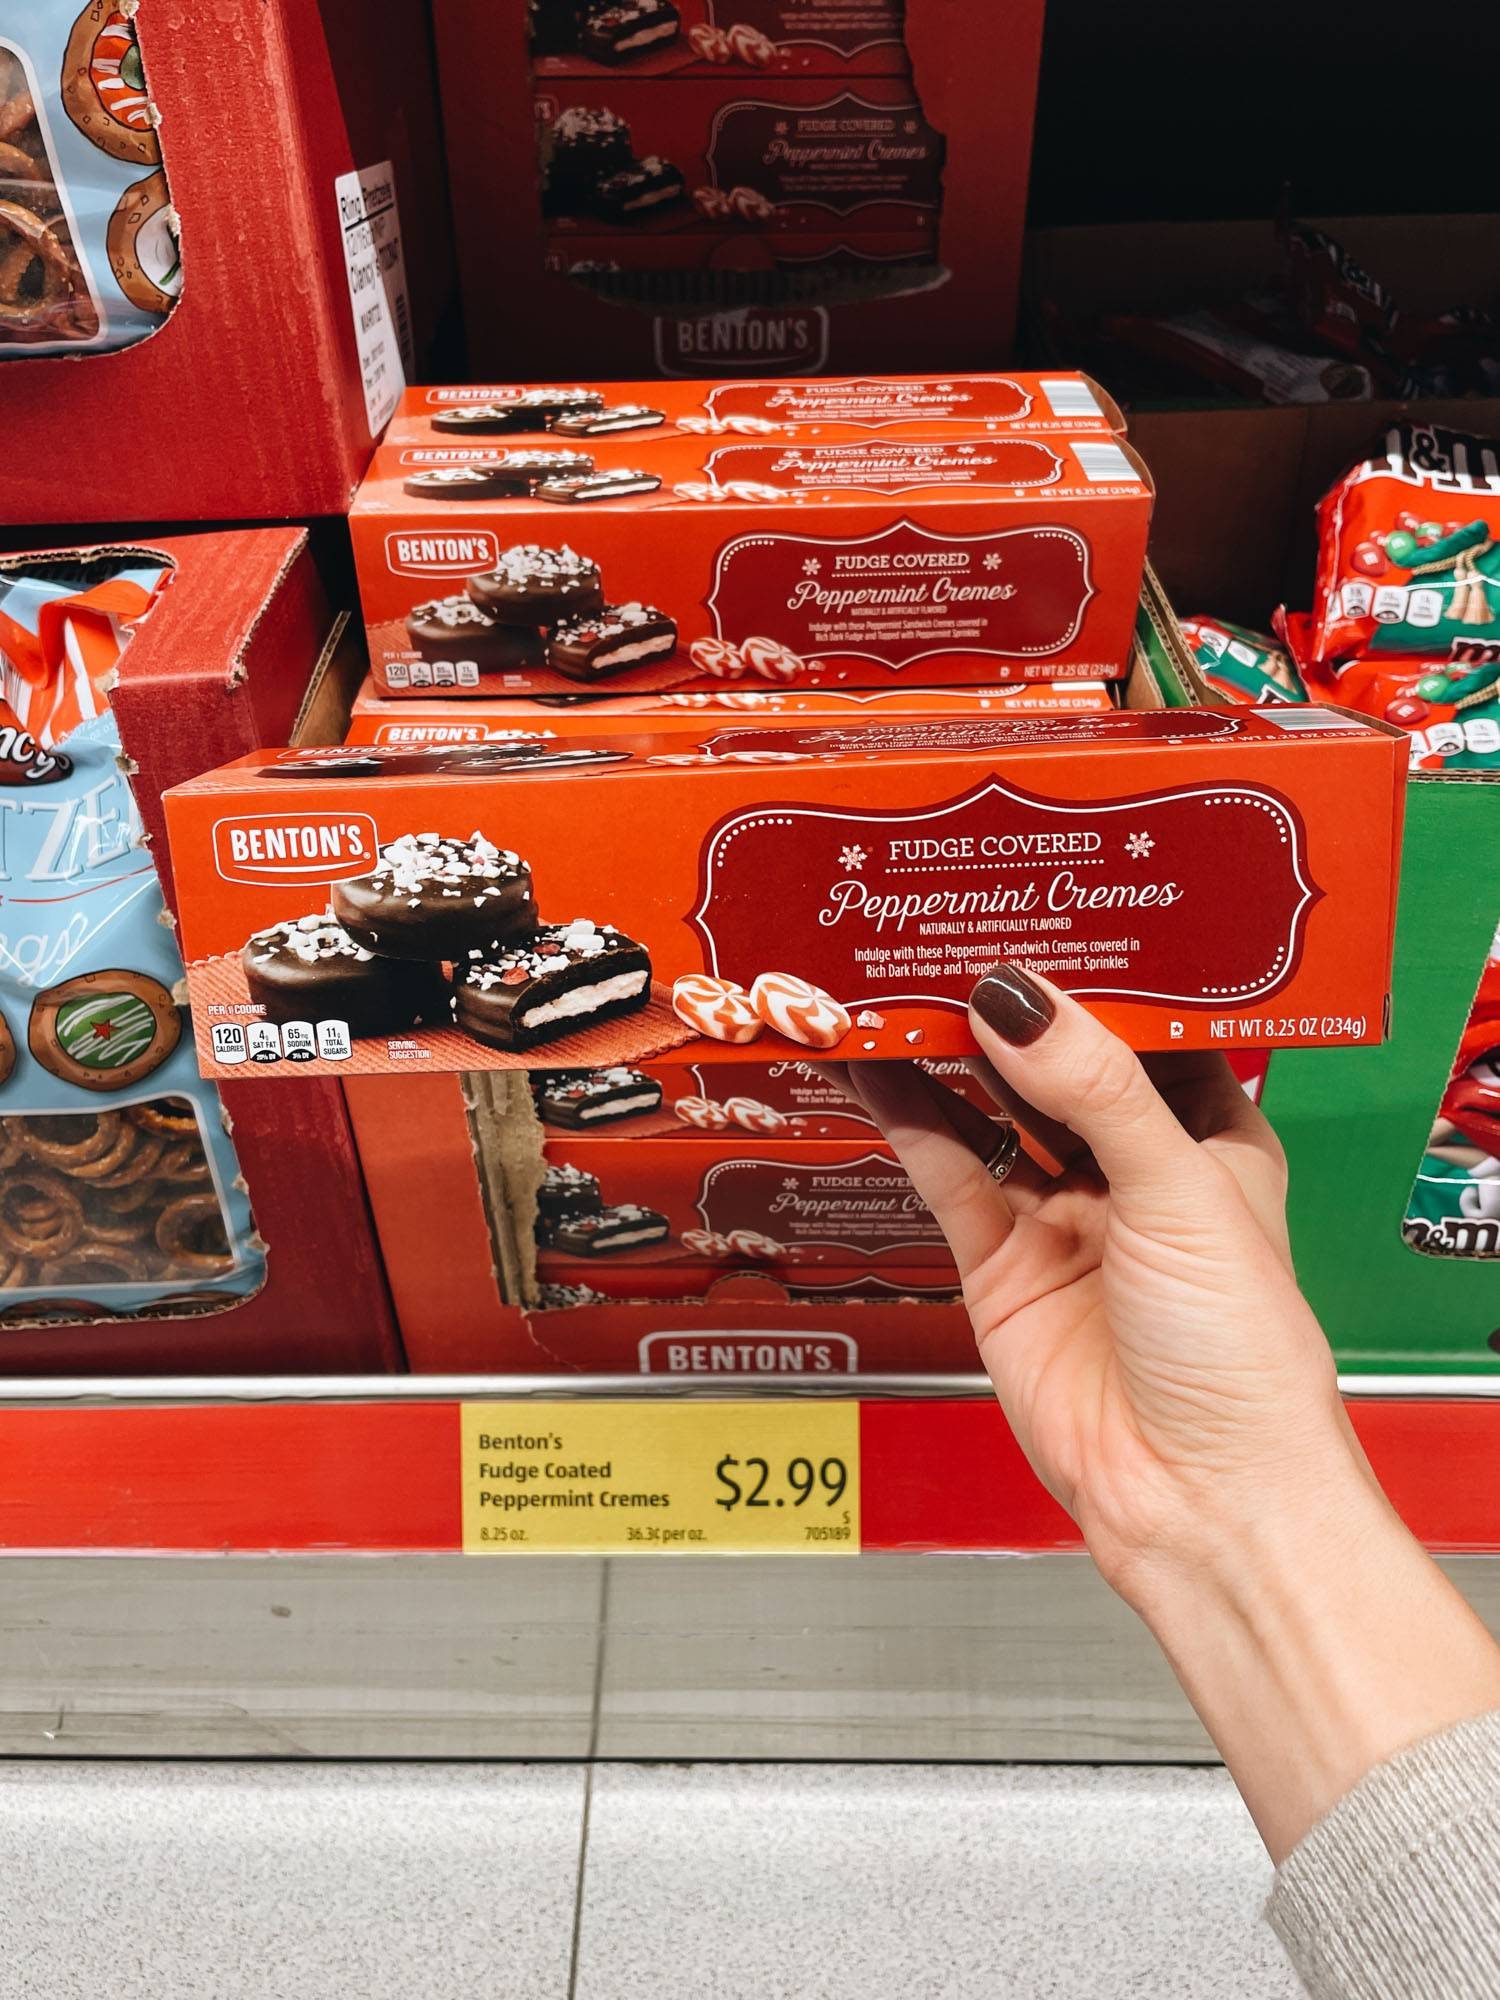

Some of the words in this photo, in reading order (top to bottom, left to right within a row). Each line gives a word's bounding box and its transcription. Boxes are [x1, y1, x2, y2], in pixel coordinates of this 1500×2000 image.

[677, 317, 808, 352] BENTON'S
[412, 450, 498, 461] BENTON'S
[771, 458, 909, 473] Peppermint
[914, 454, 998, 466] Cremes
[397, 537, 489, 562] BENTON'S
[835, 556, 890, 570] FUDGE
[893, 553, 970, 568] COVERED
[787, 580, 930, 614] Peppermint
[932, 577, 1018, 603] Cremes
[388, 666, 406, 676] 120
[1024, 666, 1040, 677] NET
[1042, 665, 1056, 676] WT
[1056, 665, 1076, 676] 8.25
[388, 728, 480, 741] BENTON'S
[1209, 736, 1235, 744] NET
[230, 824, 364, 862] BENTON'S
[889, 837, 974, 861] FUDGE
[980, 832, 1102, 857] COVERED
[818, 879, 1041, 932] Peppermint
[1047, 871, 1184, 912] Cremes
[919, 921, 966, 936] NATURALLY
[967, 922, 975, 934] &
[976, 919, 1029, 934] ARTIFICIALLY
[1030, 917, 1072, 932] FLAVORED
[854, 947, 892, 962] Indulge
[892, 946, 915, 960] with
[916, 945, 943, 959] these
[944, 943, 1001, 962] Peppermint
[1003, 941, 1050, 956] Sandwich
[1052, 940, 1088, 954] Cremes
[1089, 938, 1128, 952] covered
[1130, 937, 1140, 951] in
[866, 964, 886, 979] Rich
[888, 962, 910, 978] Dark
[912, 962, 942, 979] Fudge
[943, 961, 962, 976] and
[964, 960, 999, 977] Topped
[1025, 957, 1082, 974] Peppermint
[1084, 955, 1129, 972] Sprinkles
[208, 1006, 225, 1016] PER
[234, 1004, 266, 1015] COOKIE
[215, 1028, 242, 1045] 120
[1210, 1020, 1236, 1038] NET
[1238, 1019, 1262, 1037] WT
[1265, 1018, 1296, 1036] 8.25
[1299, 1017, 1317, 1036] OZ
[1320, 1016, 1367, 1039] (234g)
[216, 1045, 244, 1053] CALORIES
[287, 1040, 312, 1048] SODIUM
[388, 1041, 416, 1050] SERVING
[388, 1050, 432, 1060] SUGGESTION
[812, 1177, 863, 1187] FUDGE
[768, 1193, 897, 1216] Peppermint
[667, 1343, 832, 1371] BENTON'S
[479, 1432, 563, 1450] Benton's
[480, 1462, 539, 1483] Fudge
[544, 1462, 612, 1478] Coated
[715, 1454, 848, 1512] $2.99
[480, 1490, 594, 1511] Peppermint
[600, 1491, 670, 1508] Cremes
[480, 1526, 508, 1542] 8.25
[510, 1529, 528, 1542] oz.
[662, 1529, 686, 1544] per
[688, 1529, 708, 1541] oz.
[804, 1526, 851, 1541] 705189
